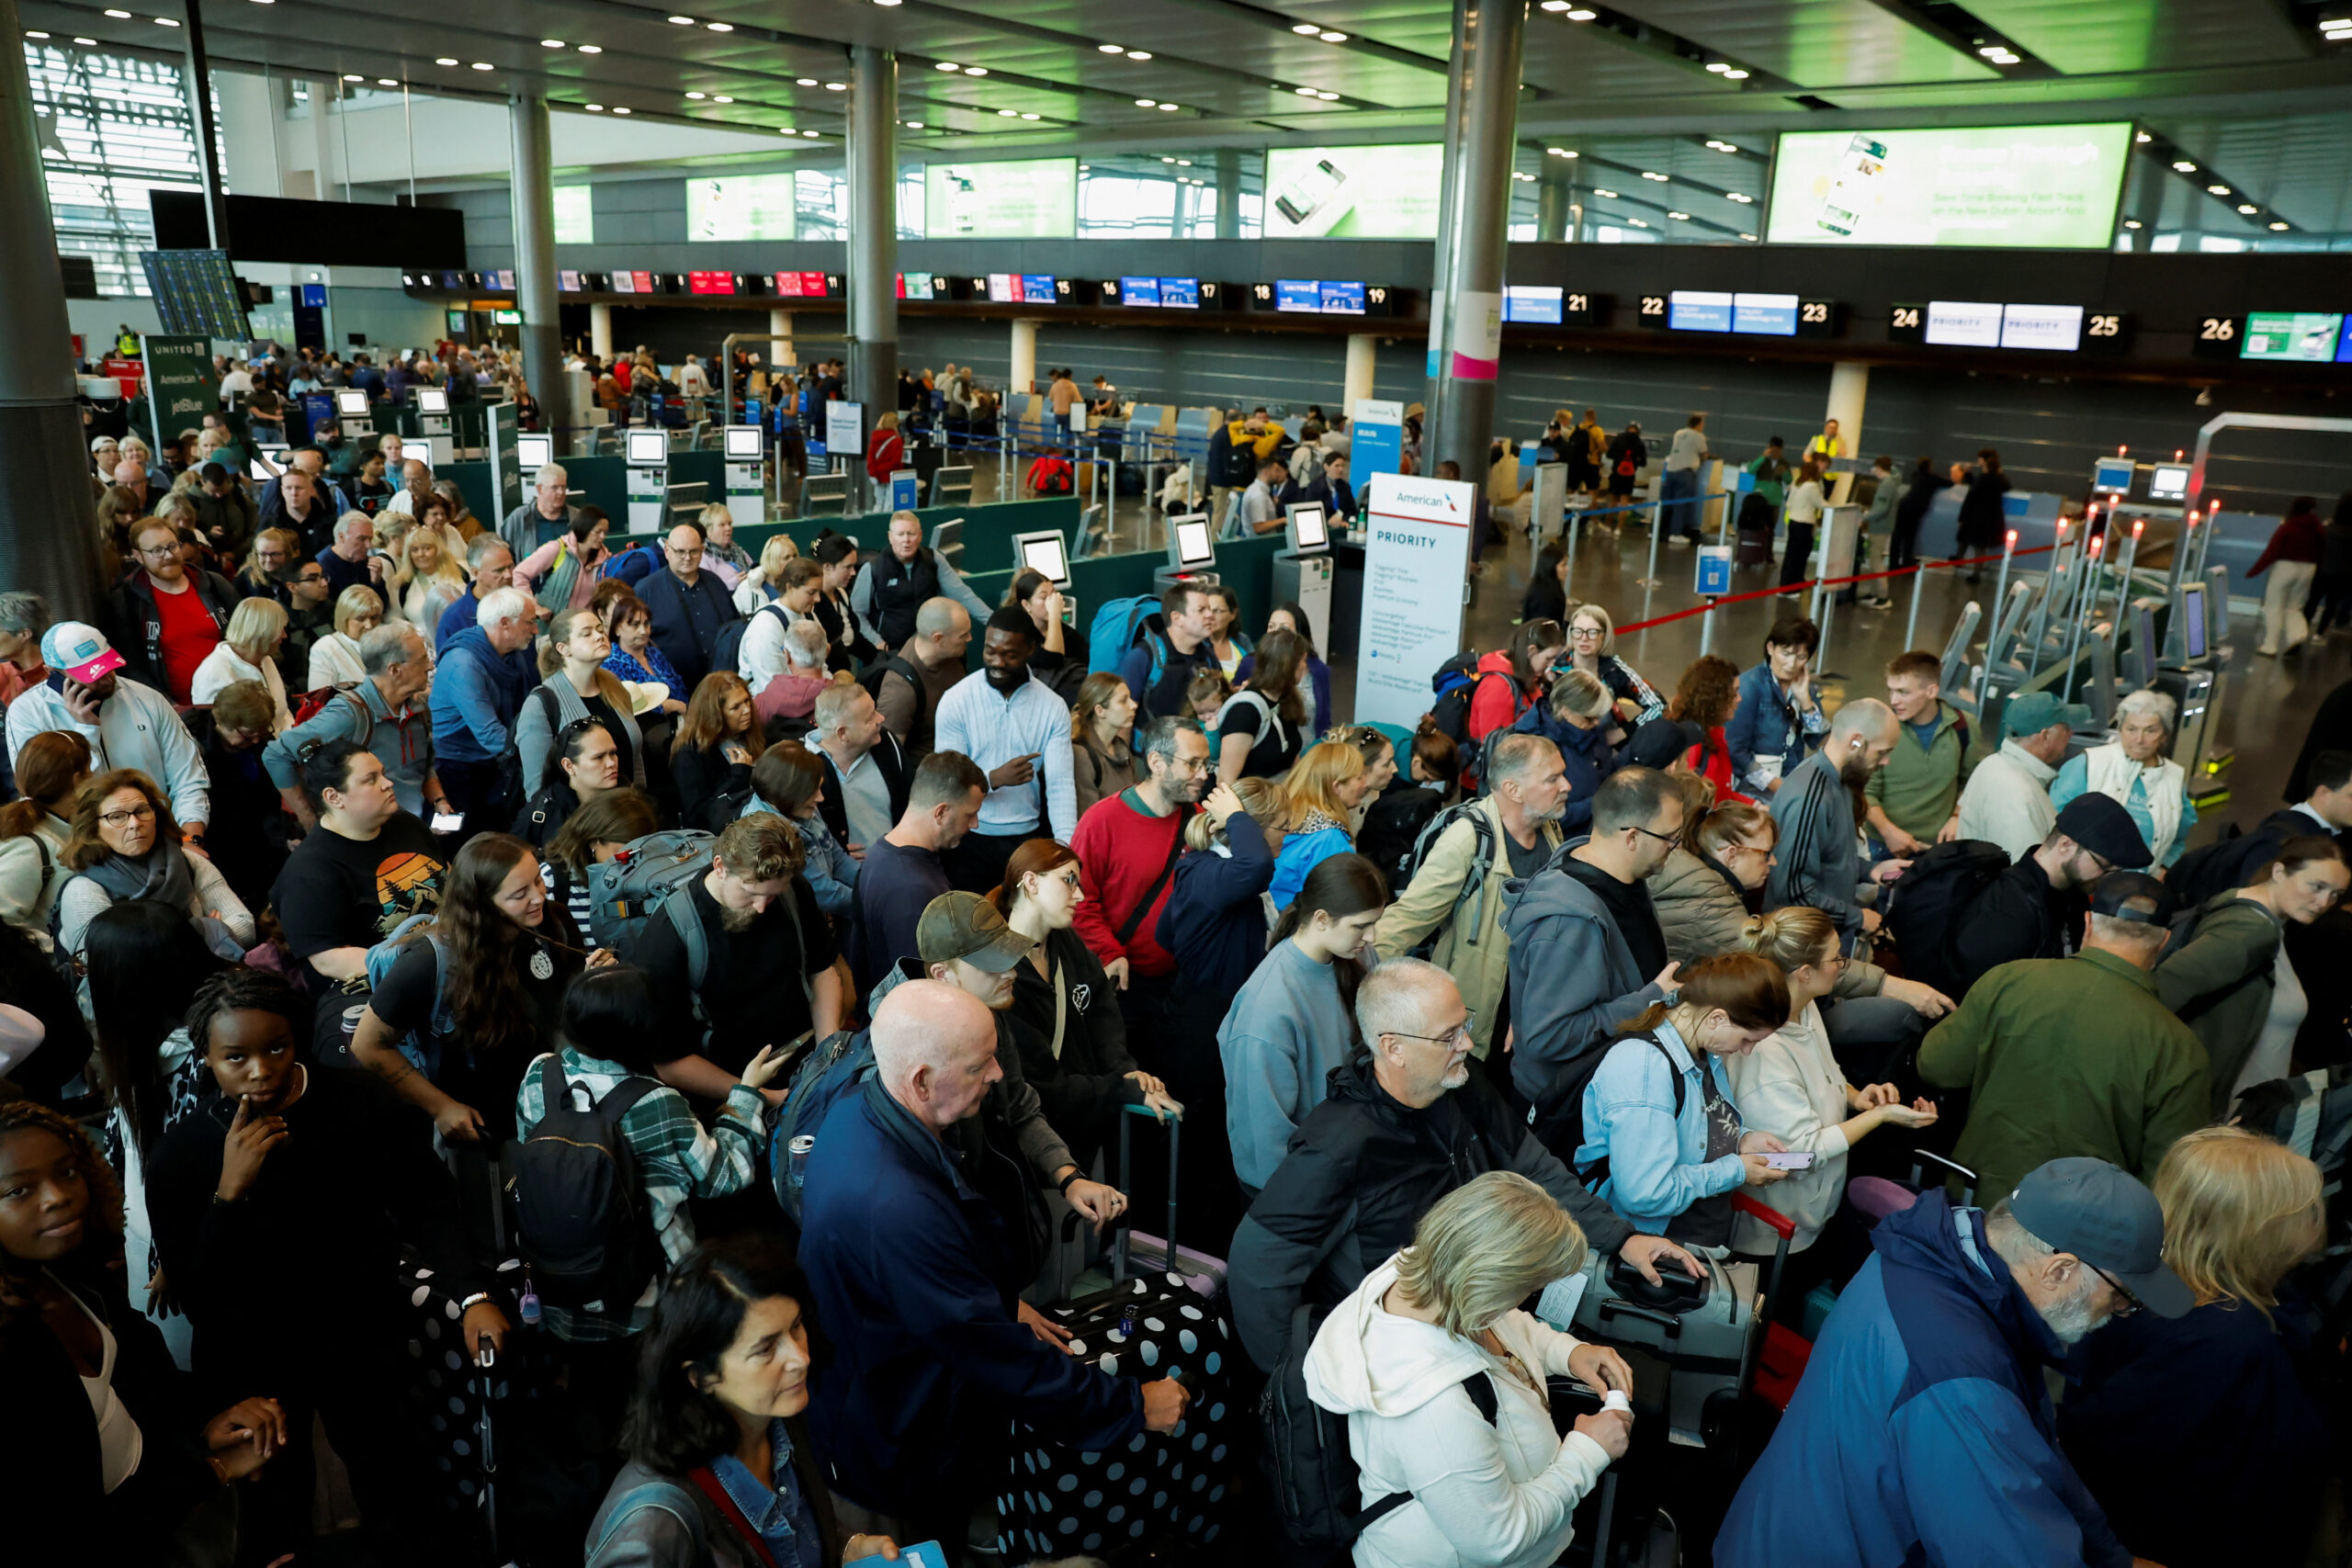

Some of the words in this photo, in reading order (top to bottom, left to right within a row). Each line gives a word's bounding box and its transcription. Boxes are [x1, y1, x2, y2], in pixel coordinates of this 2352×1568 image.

[736, 276, 743, 288] 9
[827, 276, 838, 288] 11
[933, 277, 946, 291] 13
[973, 278, 986, 291] 14
[1057, 280, 1070, 295] 15
[1102, 281, 1117, 296] 16
[1201, 284, 1216, 298] 17
[1255, 285, 1271, 300] 18
[1368, 288, 1385, 304] 19
[1568, 294, 1588, 311] 21
[1642, 297, 1664, 315] 22
[1803, 303, 1827, 322] 23
[1893, 308, 1919, 328] 24
[1933, 318, 1981, 326] PRIORITY
[2008, 321, 2059, 329] PRIORITY
[2088, 315, 2120, 336] 25
[2200, 318, 2233, 341] 26
[154, 345, 193, 355] UNITED
[160, 375, 196, 385] American
[1396, 491, 1442, 507] American
[1377, 530, 1436, 548] PRIORITY
